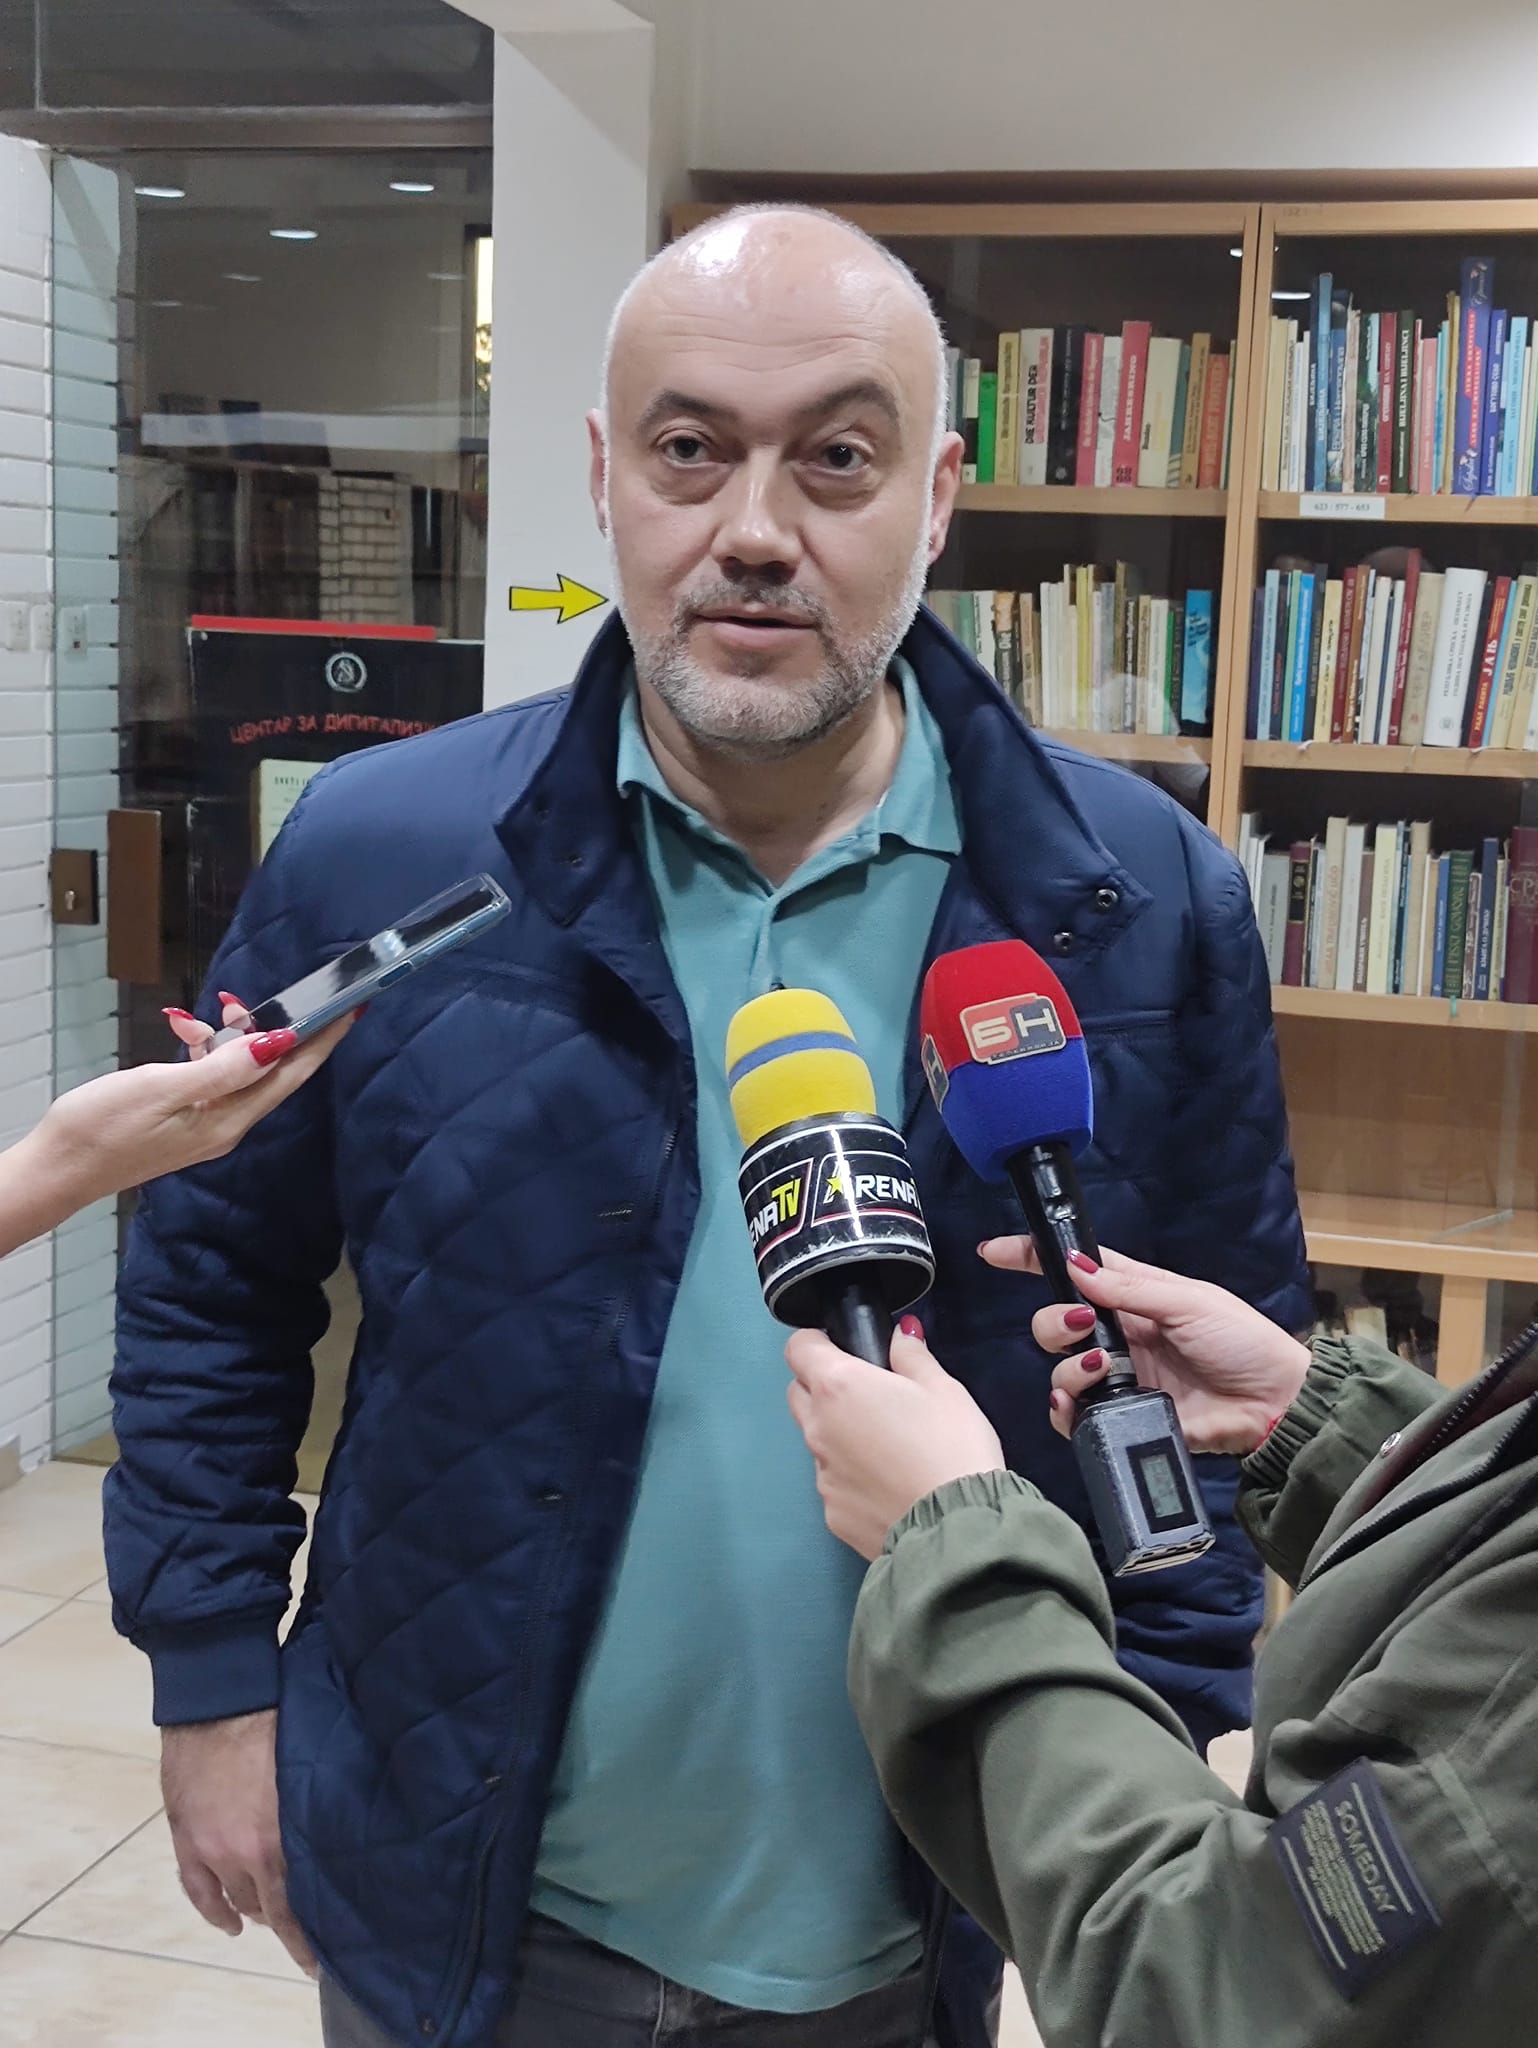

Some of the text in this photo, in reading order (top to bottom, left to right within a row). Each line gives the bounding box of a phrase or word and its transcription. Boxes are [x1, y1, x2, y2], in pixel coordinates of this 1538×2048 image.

[1024, 365, 1038, 444] DIE KULTUR DER
[1481, 639, 1498, 677] ЈАЊ
[230, 715, 293, 744] ЦЕНТАР
[297, 715, 318, 732] ЗА
[1334, 1800, 1398, 1912] SOMEDAY
